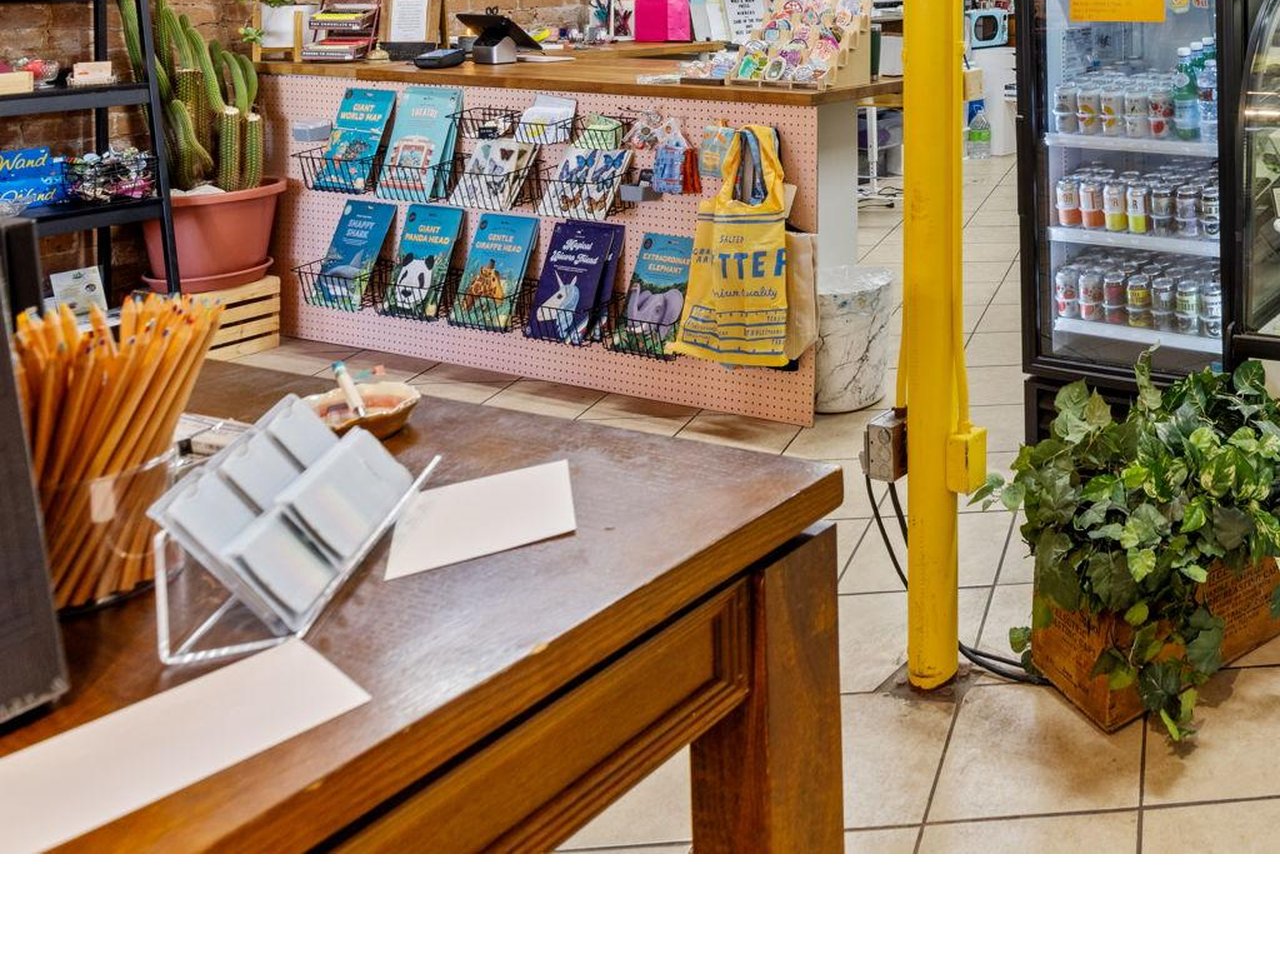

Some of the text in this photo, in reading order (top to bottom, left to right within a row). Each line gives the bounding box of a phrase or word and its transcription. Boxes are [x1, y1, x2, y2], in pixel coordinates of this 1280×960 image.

[353, 103, 376, 112] GIANT
[340, 112, 382, 121] WORLD MAP
[0, 152, 48, 170] Wand
[345, 229, 369, 239] SHARK
[418, 225, 441, 233] GIANT
[404, 233, 450, 245] PANDA HEAD
[488, 233, 514, 242] GENTLE
[475, 242, 522, 253] GIRAFFE HEAD
[647, 263, 682, 274] ELEPHANT
